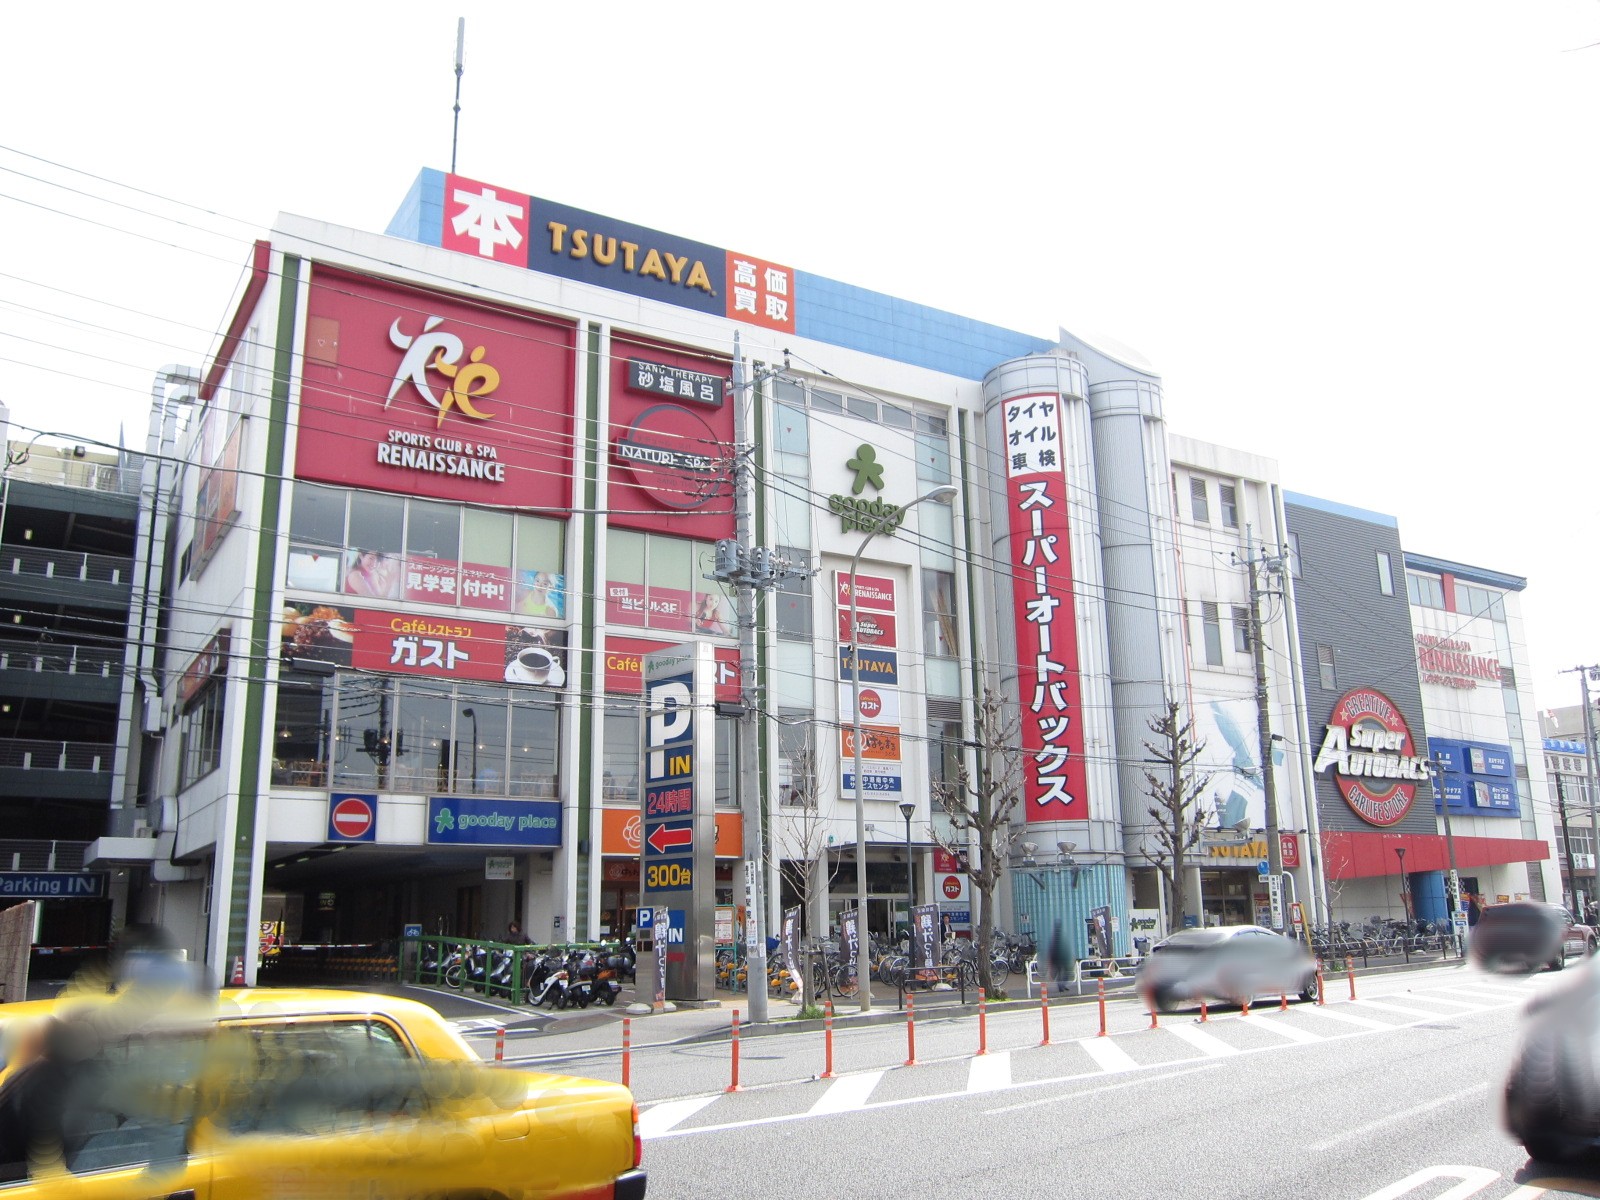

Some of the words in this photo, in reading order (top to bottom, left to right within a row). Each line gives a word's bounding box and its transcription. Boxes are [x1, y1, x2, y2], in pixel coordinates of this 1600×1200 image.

[451, 187, 523, 257] 本
[548, 221, 712, 291] TSUTAYA
[733, 259, 787, 296] 高価
[733, 287, 788, 322] 買取
[638, 371, 714, 401] 砂塩風呂
[669, 368, 713, 384] THERAPY
[1007, 401, 1055, 423] タイヤ
[388, 429, 431, 448] SPORTS
[434, 437, 462, 453] CLUB
[465, 443, 474, 455] &
[476, 444, 498, 460] SPA
[1009, 426, 1057, 446] オイル
[377, 442, 505, 483] RENAISSANCE
[1012, 449, 1057, 470] 車検
[406, 571, 505, 601] 見学受付中!
[854, 588, 893, 601] RENAISSANCE
[860, 621, 877, 629] Super
[390, 636, 470, 670] ガスト
[1018, 480, 1075, 807] スーパーオートバックス
[842, 657, 894, 673] TUTAYA
[1418, 646, 1502, 680] RENAISSANCE
[861, 701, 879, 710] ガスト
[1345, 693, 1391, 723] CREATIVE
[650, 682, 691, 779] P
[1350, 724, 1406, 752] Super
[669, 754, 691, 776] IN
[1314, 724, 1430, 781] AUTOBACS
[647, 788, 691, 815] 24時間
[1385, 787, 1408, 821] STORE
[458, 812, 515, 831] gooday
[518, 814, 557, 831] place
[67, 877, 95, 893] IN
[647, 863, 692, 888] 300台
[639, 910, 650, 927] P
[668, 928, 683, 943] IN
